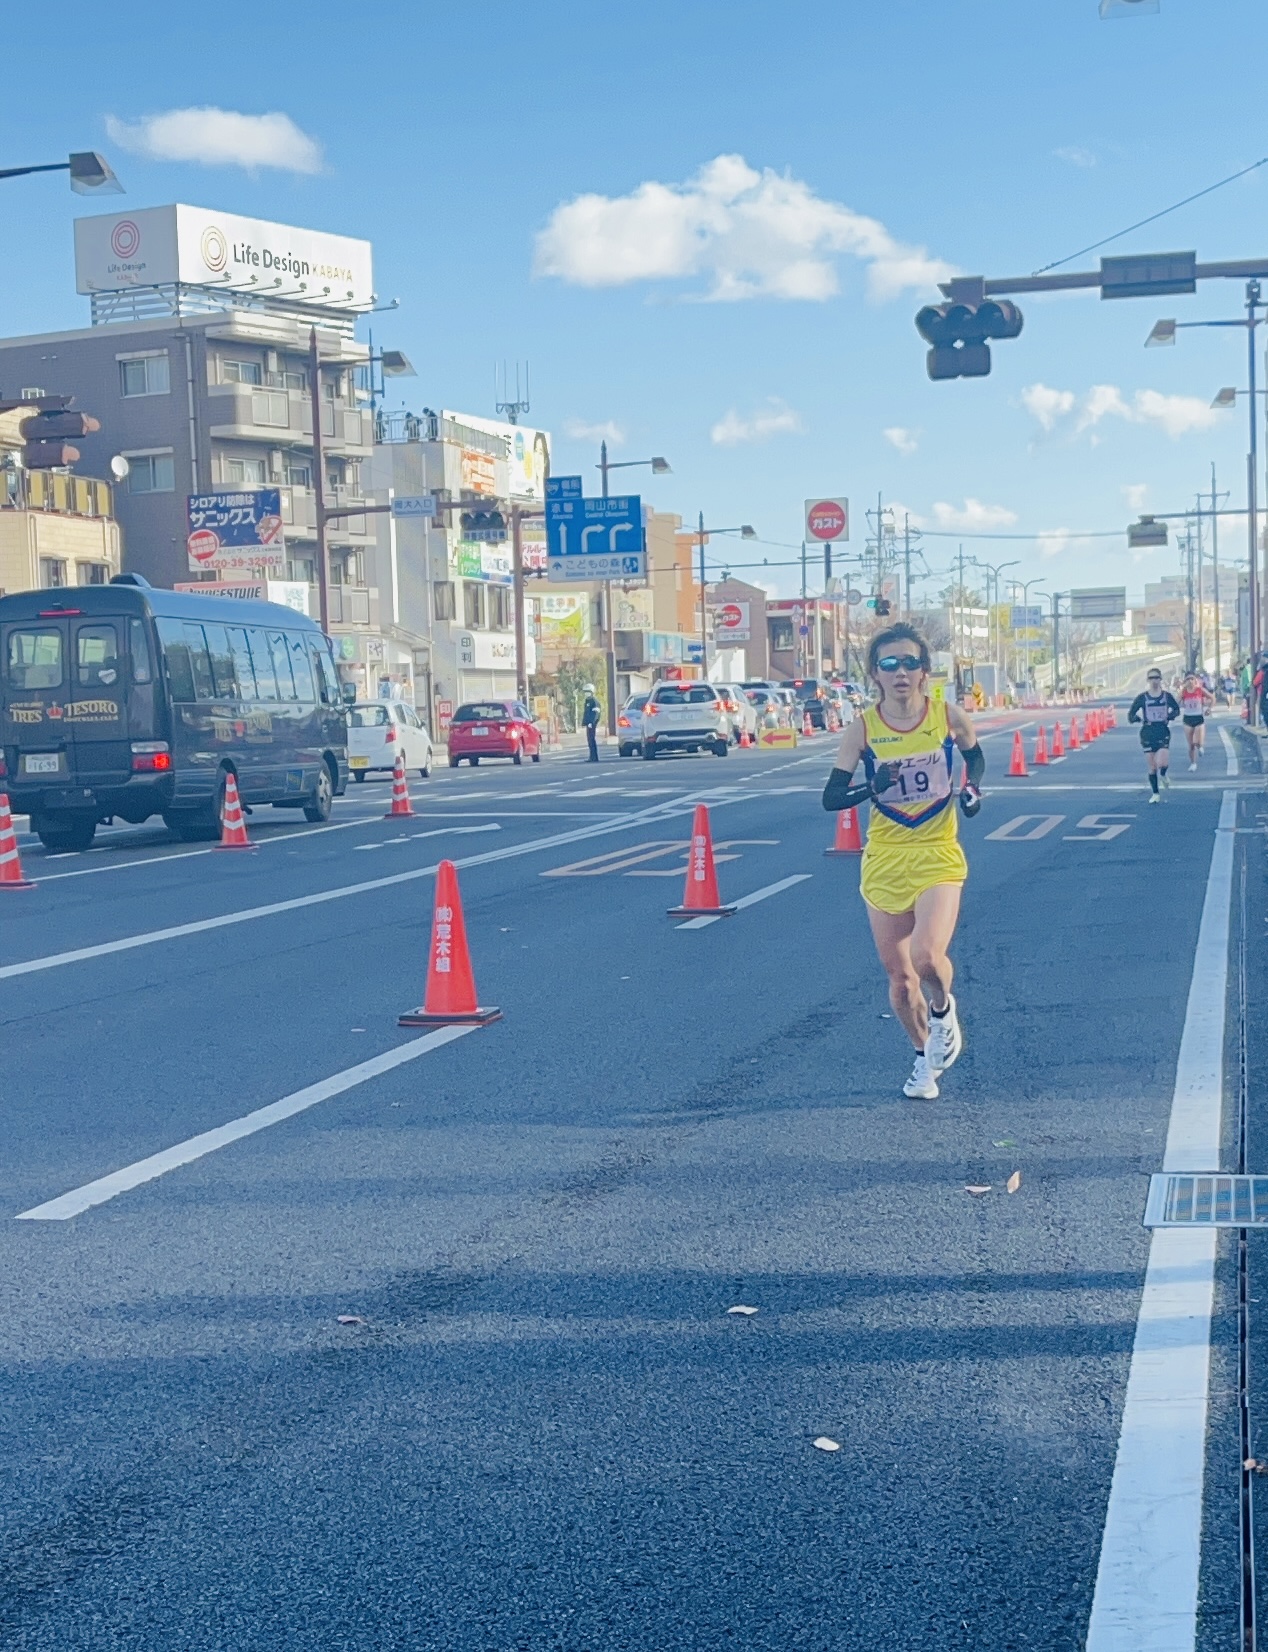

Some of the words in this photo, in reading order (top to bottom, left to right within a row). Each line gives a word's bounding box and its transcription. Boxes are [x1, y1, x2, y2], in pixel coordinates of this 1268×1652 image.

[233, 242, 260, 267] Life
[262, 249, 310, 279] Design
[312, 263, 353, 283] KABAYA
[189, 507, 257, 528] サニックス
[812, 517, 842, 529] ガスト
[566, 558, 620, 570] こどもの森
[9, 708, 43, 723] TRES
[63, 699, 118, 717] TESORO
[898, 770, 929, 796] 19
